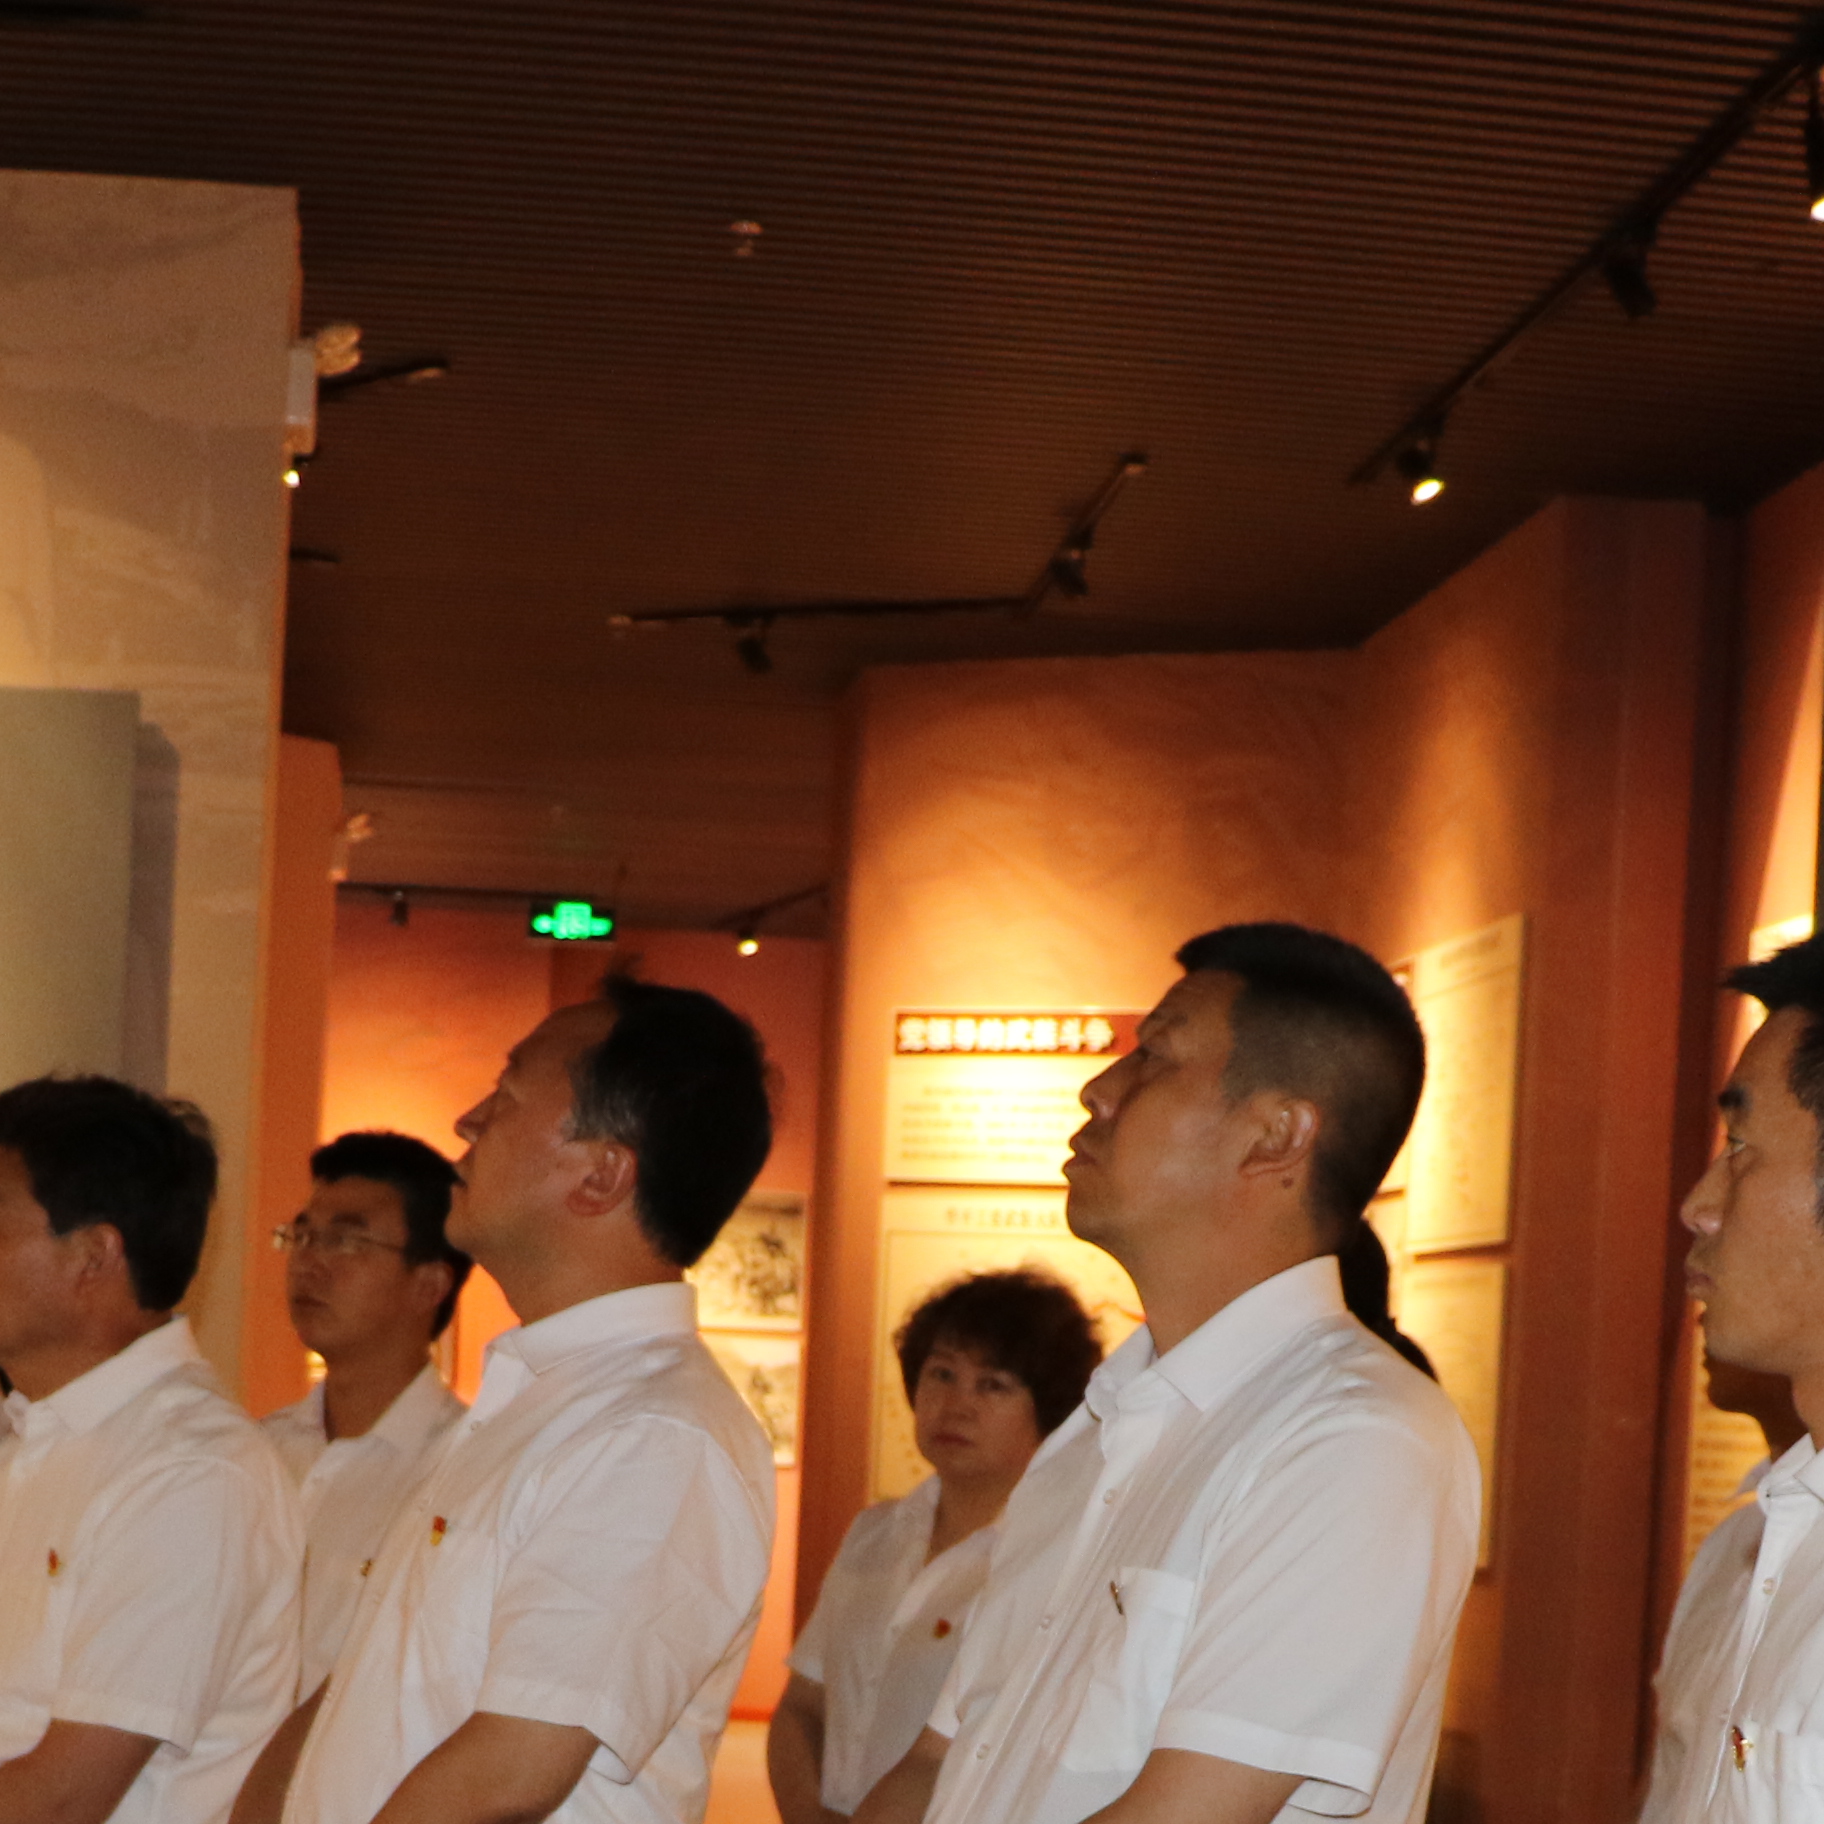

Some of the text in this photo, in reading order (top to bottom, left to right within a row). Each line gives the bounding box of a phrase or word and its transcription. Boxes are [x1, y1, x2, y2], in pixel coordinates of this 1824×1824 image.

[898, 1016, 1114, 1051] 党领导的武装斗争
